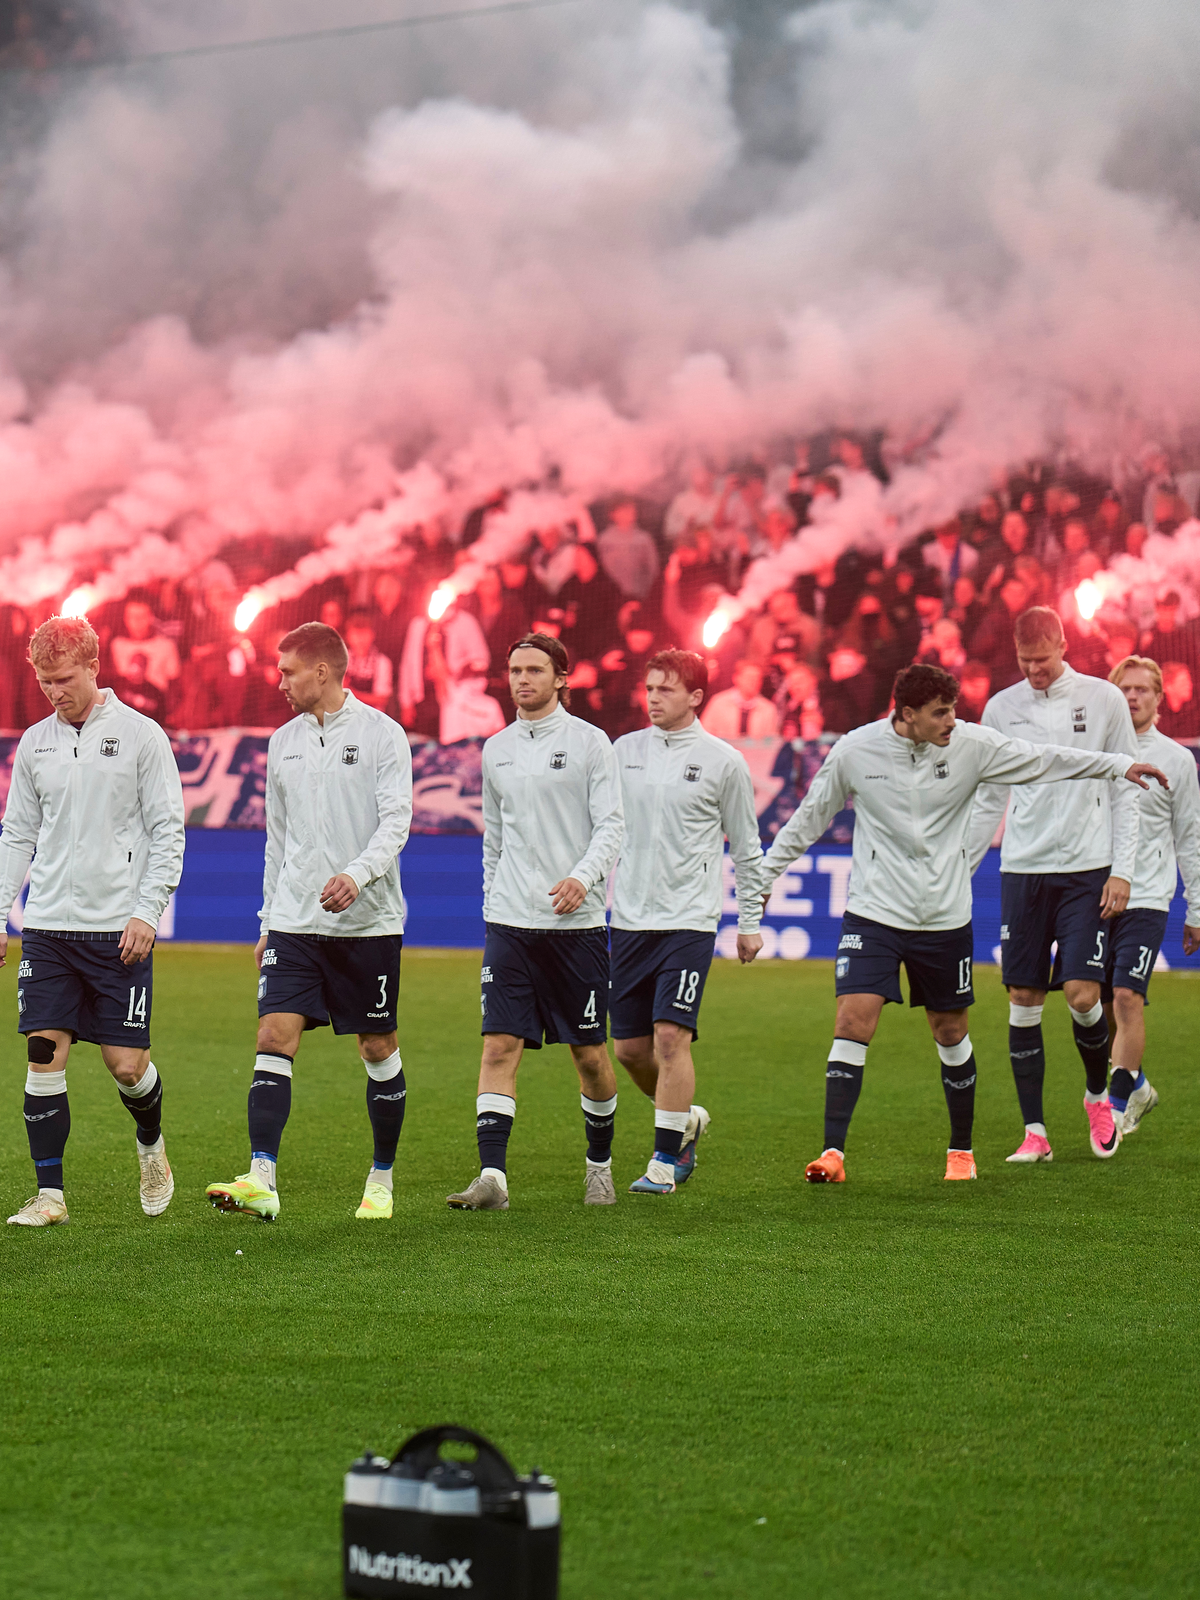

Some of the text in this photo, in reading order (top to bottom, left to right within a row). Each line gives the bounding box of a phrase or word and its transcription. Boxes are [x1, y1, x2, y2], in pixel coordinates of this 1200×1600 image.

[1094, 931, 1105, 961] 5
[1132, 945, 1152, 976] 31
[676, 969, 699, 1004] 18
[958, 957, 971, 989] 13
[127, 986, 147, 1022] 14
[375, 975, 388, 1009] 3
[584, 990, 597, 1022] 4
[123, 1021, 142, 1029] CRAFT
[348, 1544, 473, 1590] NutritionX
